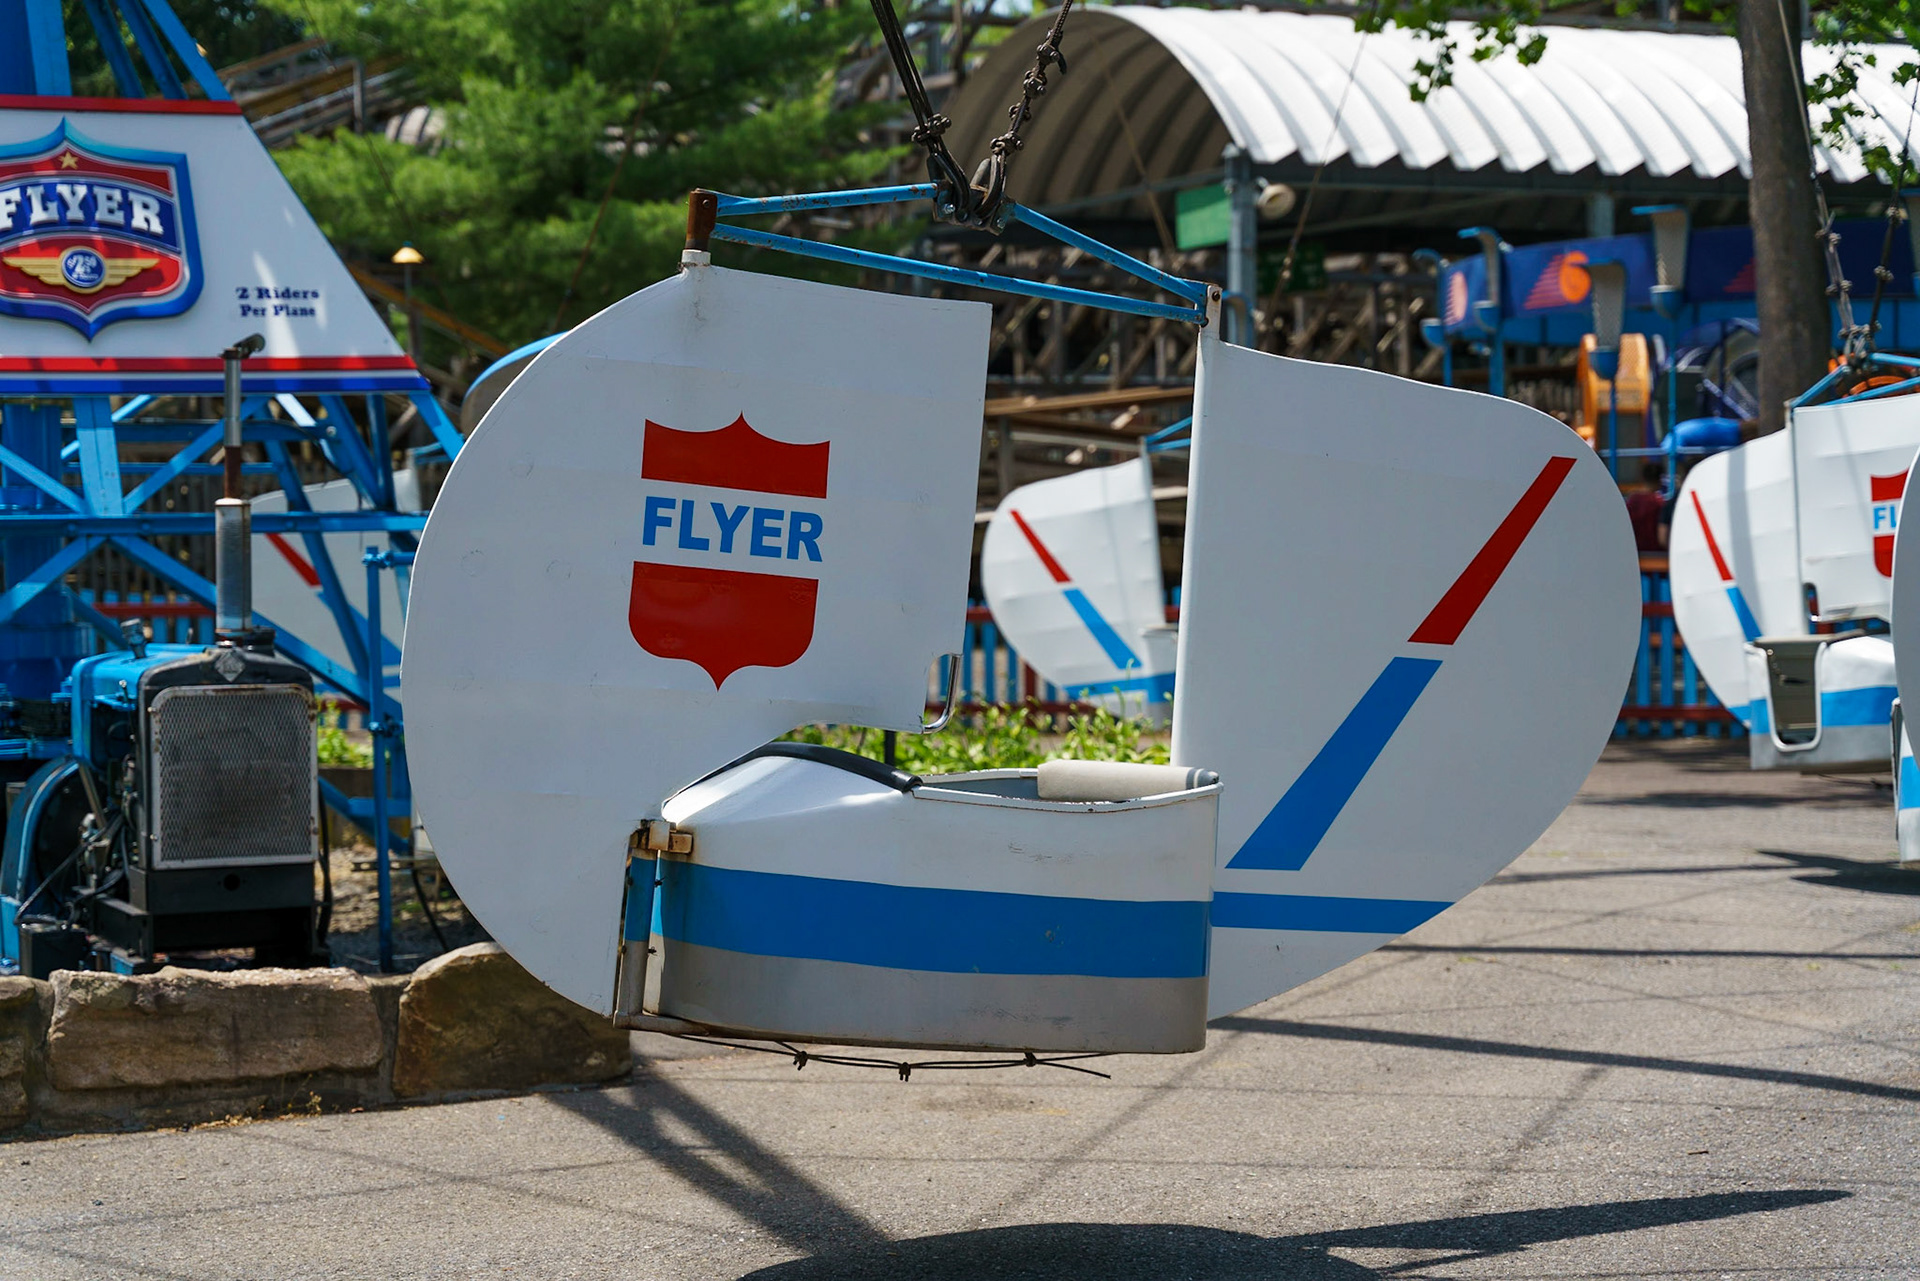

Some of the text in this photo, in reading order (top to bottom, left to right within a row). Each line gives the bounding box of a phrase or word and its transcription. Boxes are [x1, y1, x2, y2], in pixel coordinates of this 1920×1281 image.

[0, 184, 164, 237] FLYER
[236, 286, 319, 299] 2 Riders
[240, 304, 316, 316] Per Plane
[642, 496, 823, 562] FLYER
